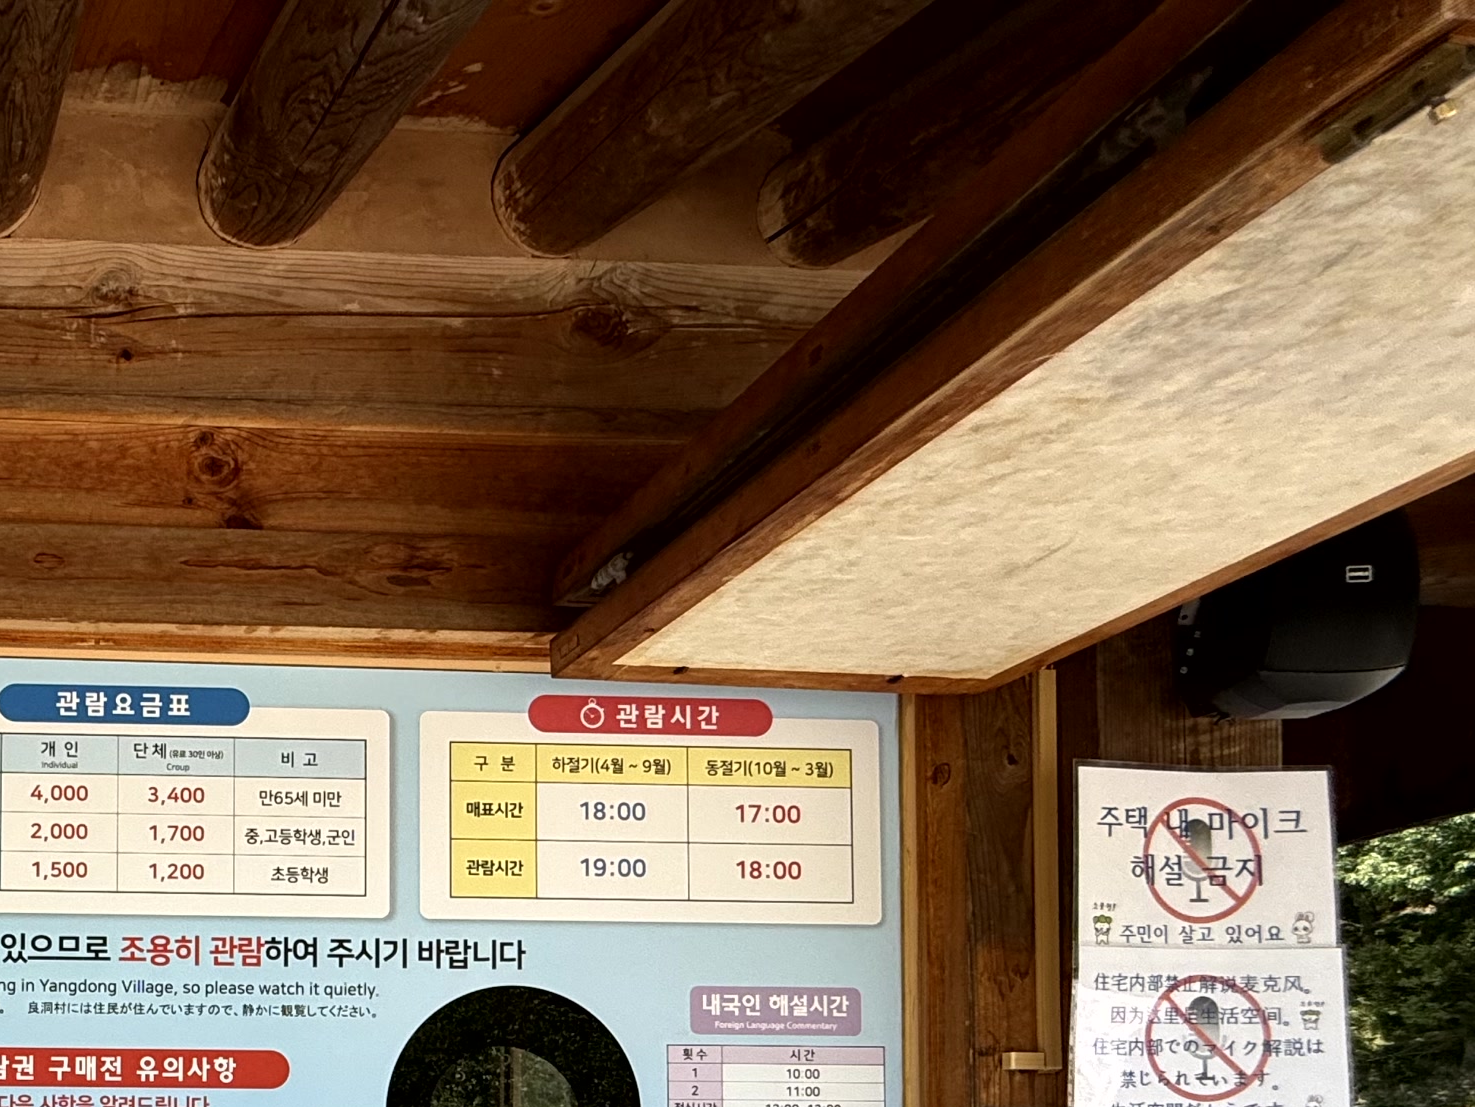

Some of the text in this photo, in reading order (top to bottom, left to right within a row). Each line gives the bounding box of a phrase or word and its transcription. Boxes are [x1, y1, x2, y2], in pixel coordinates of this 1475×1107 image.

[56, 691, 190, 717] 관람요금표
[615, 703, 719, 729] 관람시간
[40, 760, 78, 769] Individual
[29, 784, 88, 804] 4,000
[147, 786, 205, 806] 3,400
[258, 789, 342, 808] 만65세 미만
[465, 801, 523, 818] 매표시간
[579, 801, 646, 821] 18:00
[735, 804, 801, 824] 17:00
[30, 822, 88, 842] 2,000
[1097, 807, 1308, 839] 주택 내 마이크
[148, 824, 205, 844] 1,700
[31, 860, 87, 881] 1,500
[148, 862, 204, 883] 1,200
[270, 865, 328, 884] 초등학생
[465, 859, 524, 876] 관람시간
[580, 857, 646, 877] 19:00
[735, 860, 802, 880] 18:00
[1131, 854, 1263, 886] 해설 금지
[1120, 925, 1284, 944] 주민이 살고 있어요
[1, 933, 110, 963] 있으므로
[119, 935, 199, 965] 조용히
[210, 936, 316, 966] 관람하여
[327, 938, 406, 968] 주시기
[418, 939, 525, 969] 바랍니다
[20, 978, 35, 992] in
[38, 978, 117, 997] Yangdong
[120, 979, 177, 997] Village,
[182, 982, 200, 994] so
[204, 980, 254, 998] please
[258, 980, 304, 996] watch
[308, 981, 319, 996] it
[323, 981, 378, 1000] quietly.
[701, 993, 849, 1017] 내국인 해설시간
[714, 1019, 837, 1031] Foreign Language Commentary
[49, 1055, 121, 1081] 구매전
[136, 1056, 235, 1082] 유의사항
[786, 1068, 820, 1080] 10:00
[785, 1085, 820, 1097] 11:00
